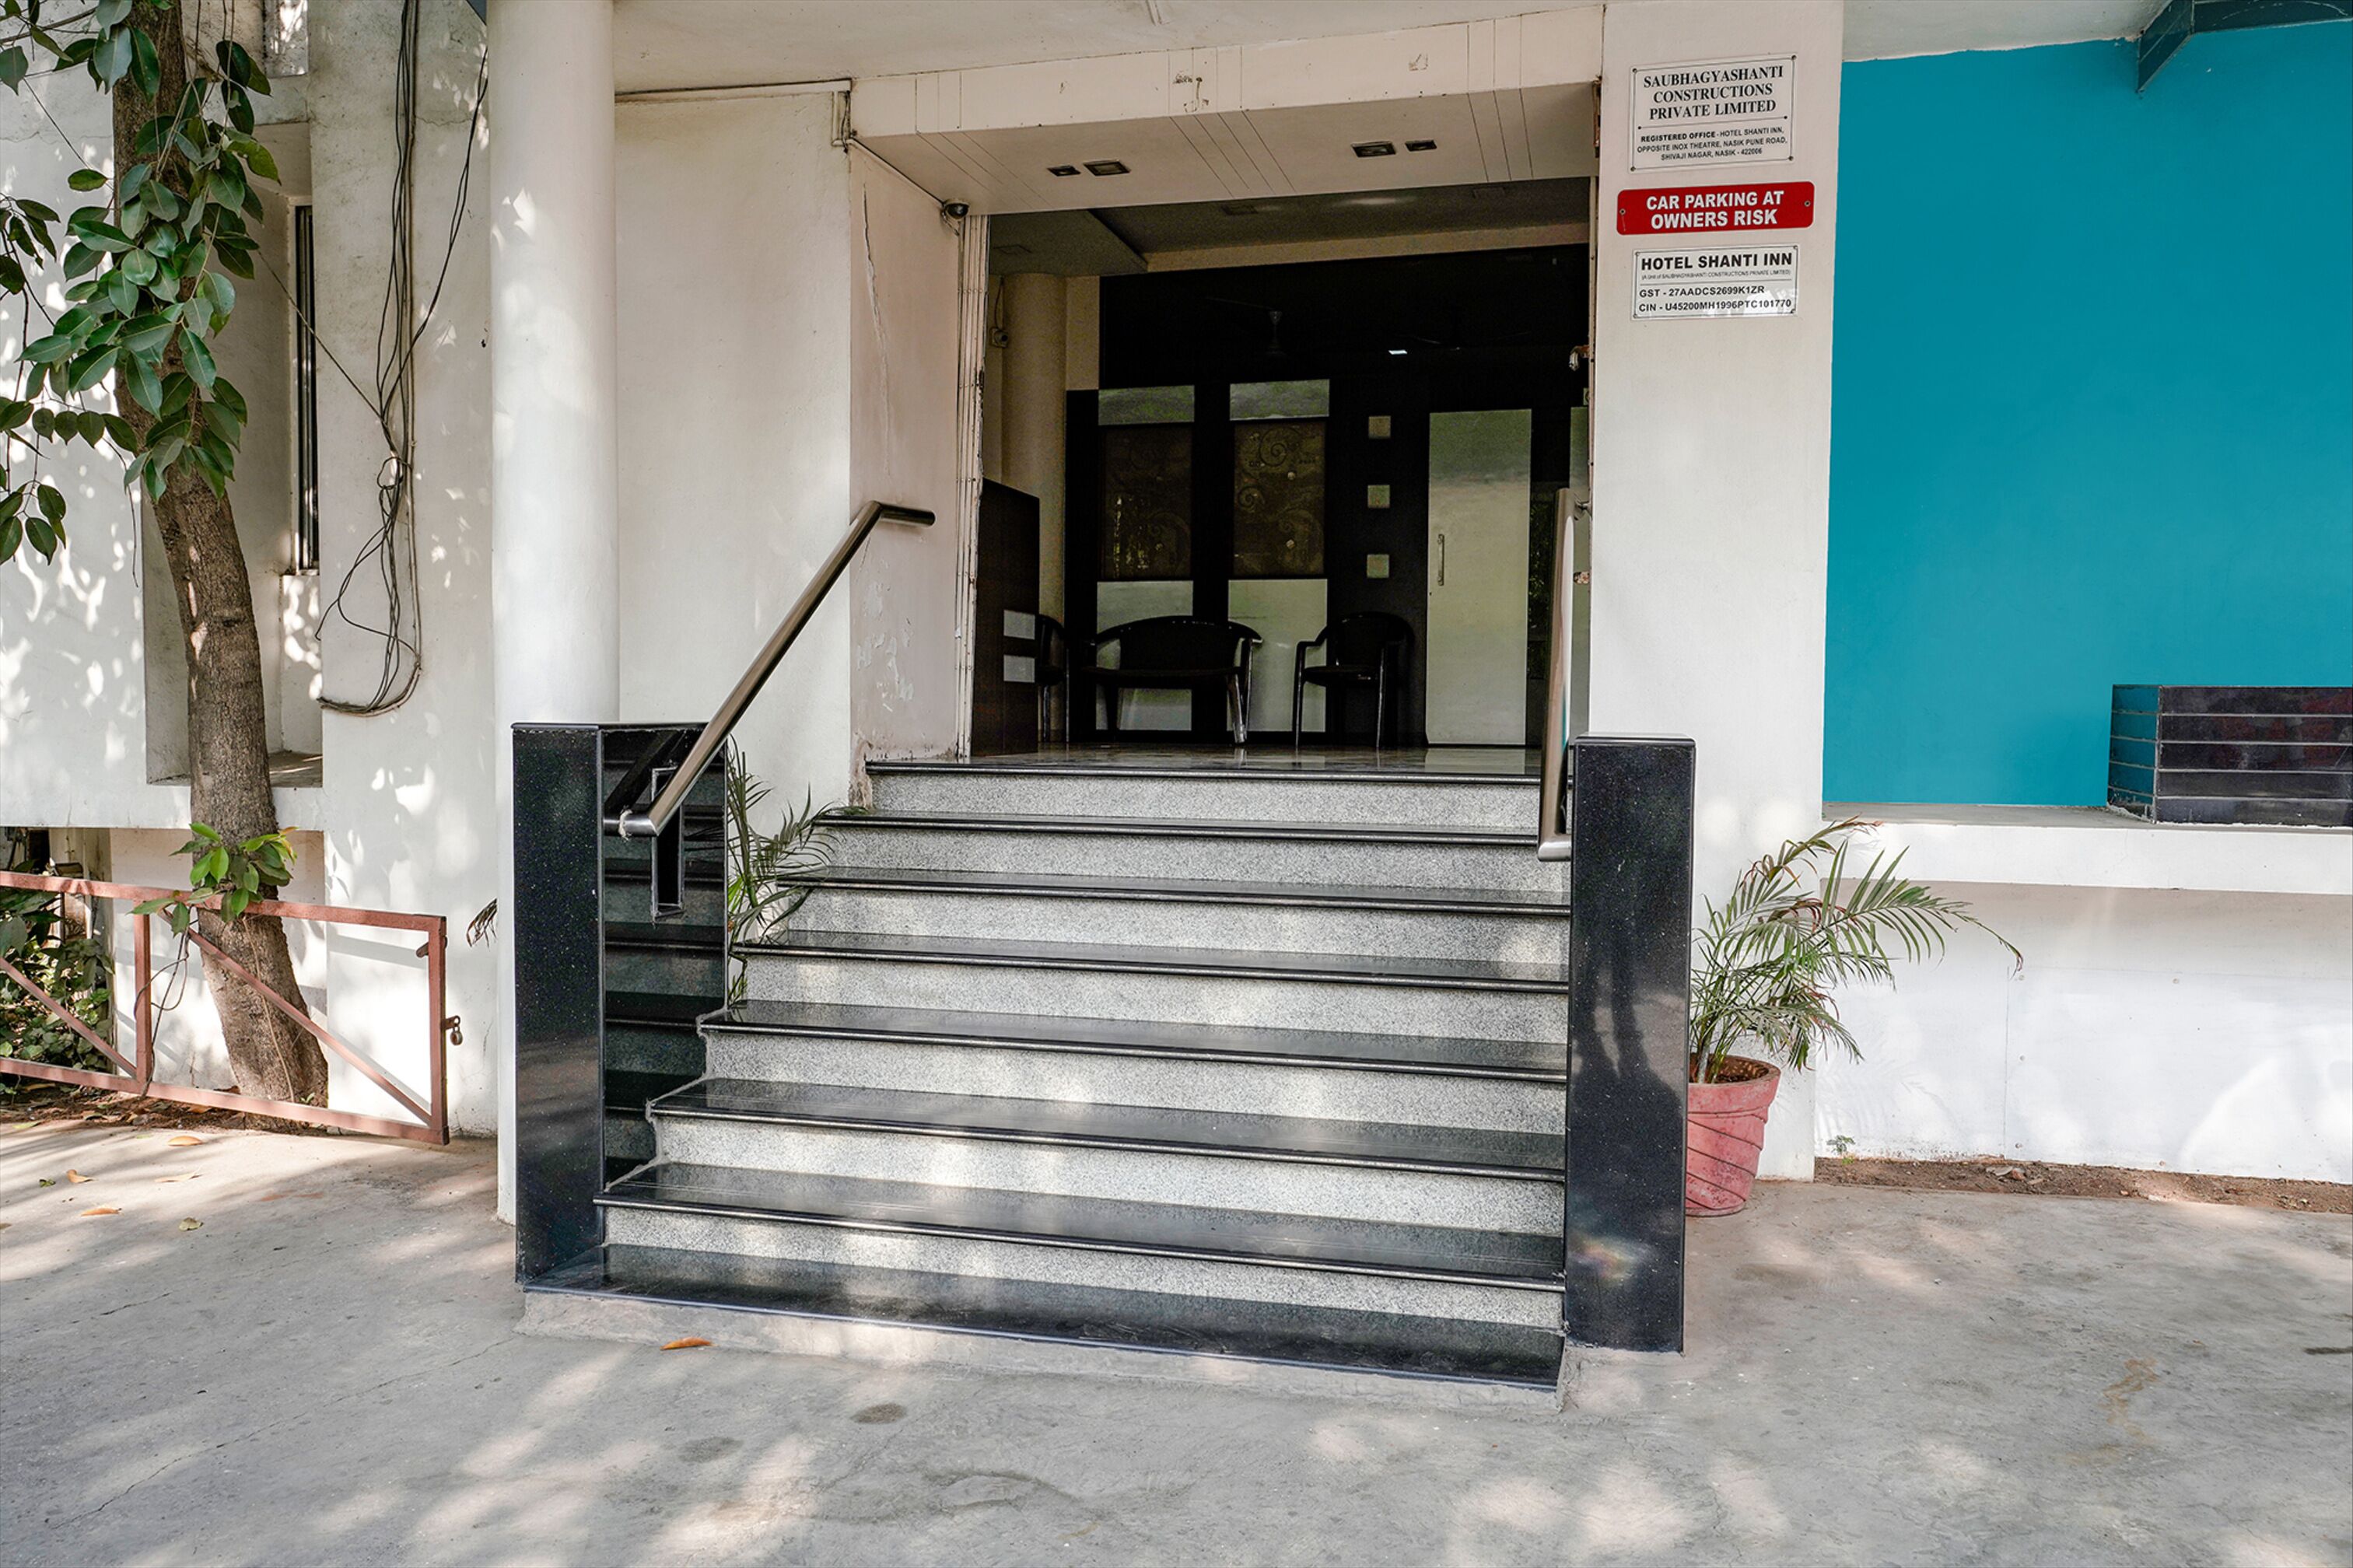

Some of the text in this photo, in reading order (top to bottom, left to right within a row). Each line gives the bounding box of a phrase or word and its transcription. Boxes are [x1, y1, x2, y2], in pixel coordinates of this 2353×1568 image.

[1643, 65, 1784, 88] SAUBHAGYASHANTI
[1653, 82, 1774, 103] CONSTRUCTIONS
[1649, 100, 1777, 120] PRIVATE LIMITED
[1640, 133, 1687, 142] REGISTERED
[1637, 145, 1670, 153] OPPOSITE
[1646, 191, 1784, 210] CAR PARKING AT
[1651, 208, 1778, 229] OWNERS RISK
[1641, 253, 1792, 271] HOTEL SHANTI INN
[1639, 289, 1660, 298] GST
[1668, 285, 1765, 296] 27AADCS2699K1ZR
[1639, 303, 1657, 312] CIN
[1665, 299, 1792, 311] U45200MH1996PTC101770
